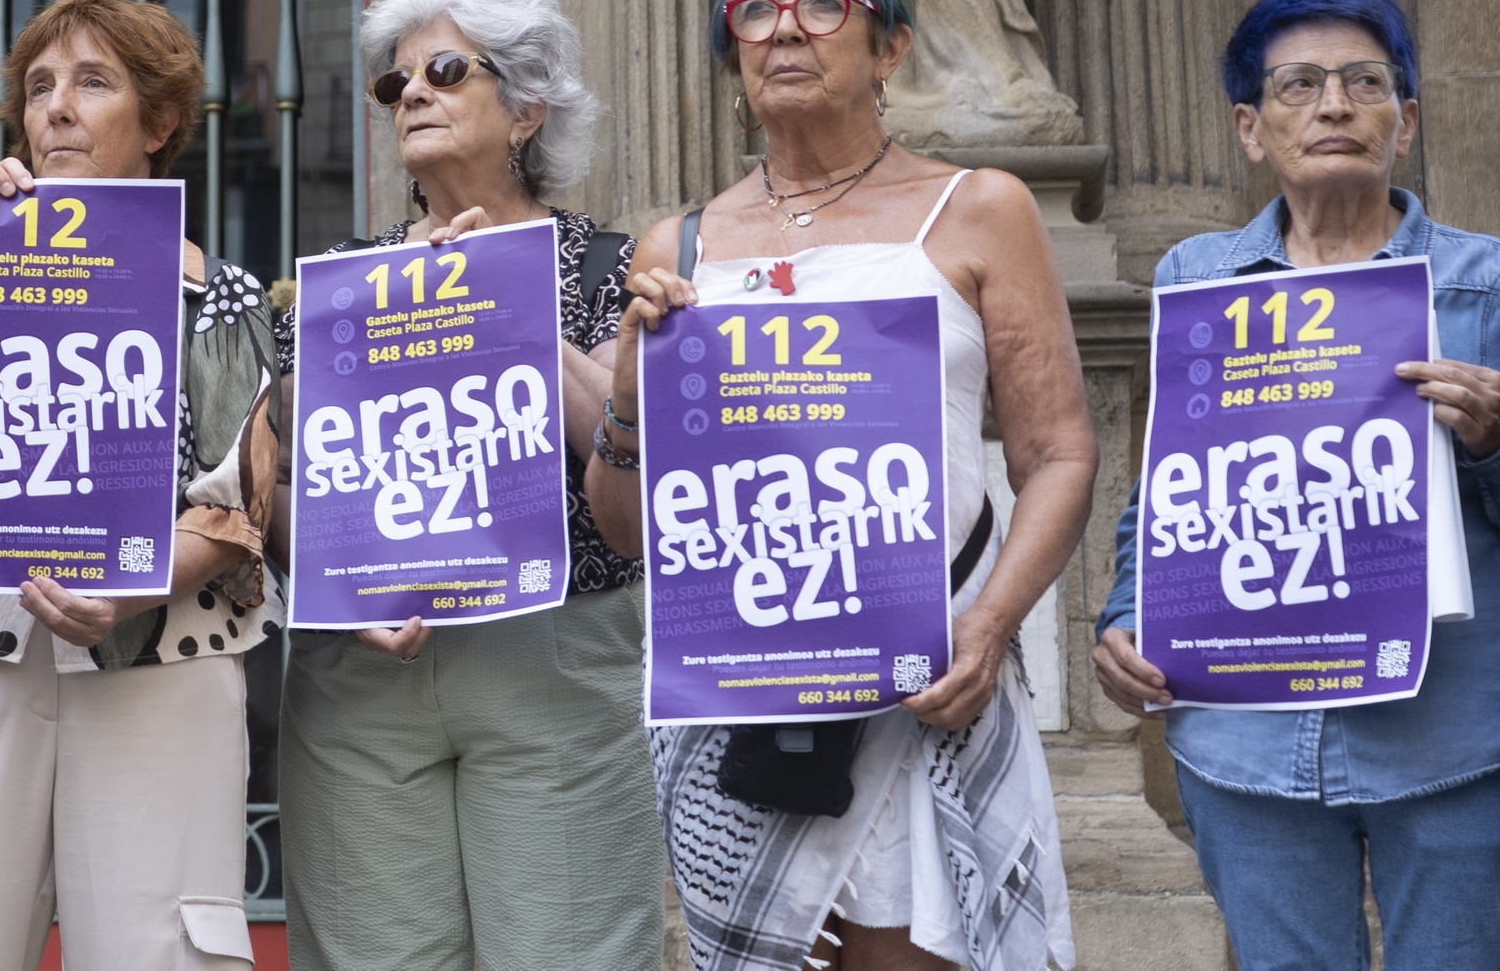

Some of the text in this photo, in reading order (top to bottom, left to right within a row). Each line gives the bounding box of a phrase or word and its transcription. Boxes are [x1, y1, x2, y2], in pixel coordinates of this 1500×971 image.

[21, 253, 69, 267] plazako
[73, 254, 114, 266] kaseta
[13, 267, 43, 277] Plaza
[47, 267, 90, 278] Castillo
[364, 253, 468, 308] 112
[10, 287, 46, 303] 463
[52, 288, 87, 305] 999
[365, 300, 495, 326] Gaztelu plazako kaseta
[1224, 288, 1334, 348] 112
[366, 314, 474, 338] Caseta Plaza Castillo
[368, 334, 473, 363] 848 463 999
[718, 315, 841, 365] 112
[1223, 345, 1361, 366] Gaztelu plazako kaseta
[720, 370, 871, 385] Gaztelu plazako kaseta
[1222, 359, 1336, 380] Caseta Plaza Castillo
[720, 383, 846, 396] Caseta Plaza Castillo
[1221, 380, 1333, 407] 848 463 999
[304, 365, 547, 468] eraso
[722, 404, 844, 424] 848 463 999
[306, 406, 553, 496] sexistarik
[1151, 418, 1413, 523] eraso
[375, 463, 493, 539] ez!
[653, 443, 929, 542] eraso
[1152, 465, 1418, 555] sexistarik
[45, 526, 60, 534] utz
[62, 526, 107, 535] dezakezu
[658, 487, 935, 573] sexistarik
[28, 566, 104, 579] 660 344 692
[324, 568, 345, 576] Zure
[347, 564, 398, 574] testigantza
[400, 560, 446, 569] anonimoa
[464, 556, 508, 565] dezakezu
[1221, 526, 1350, 610] ez!
[358, 580, 507, 595] nomasviolenciasexista@gmail.com
[734, 543, 862, 625] ez!
[433, 594, 506, 609] 660 344 692
[1290, 675, 1364, 691] 660 344 692
[798, 689, 879, 704] 660 344 692
